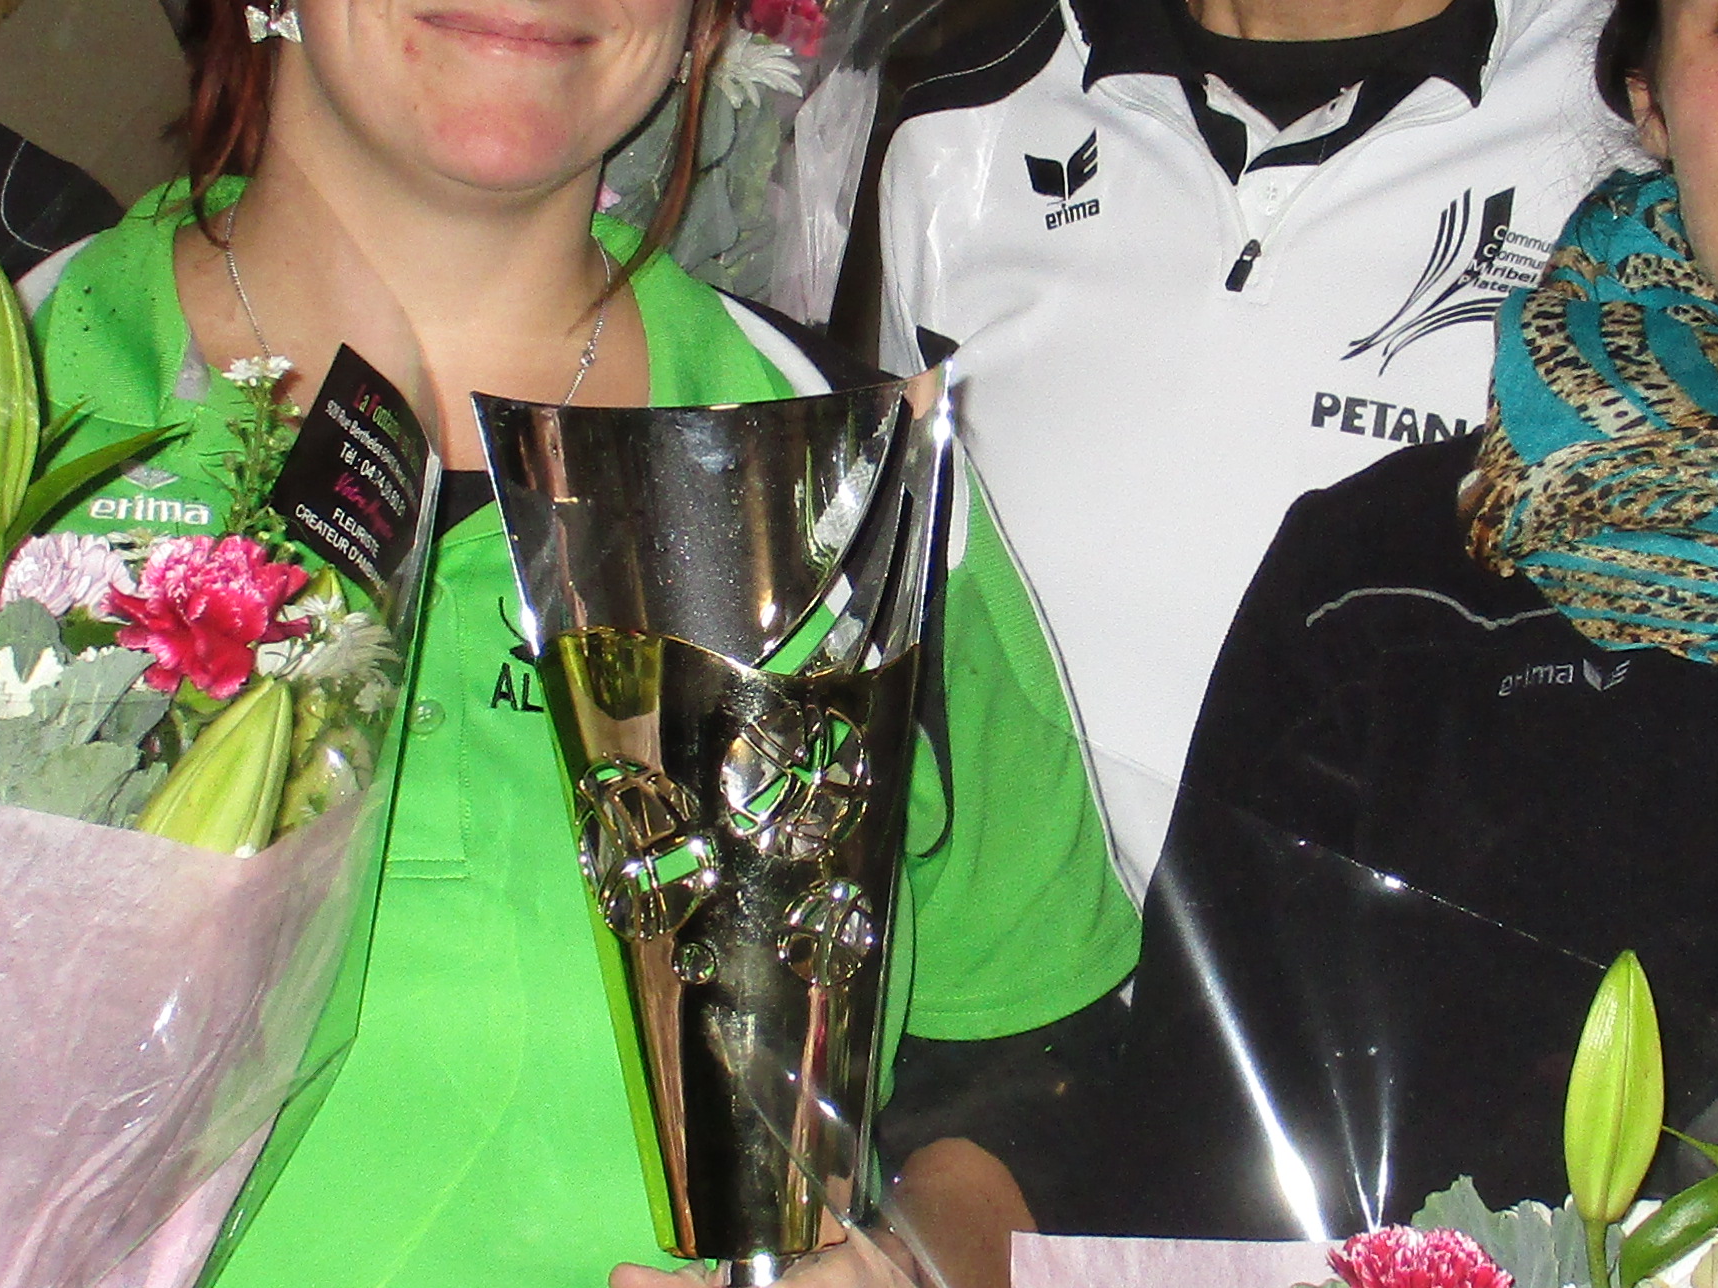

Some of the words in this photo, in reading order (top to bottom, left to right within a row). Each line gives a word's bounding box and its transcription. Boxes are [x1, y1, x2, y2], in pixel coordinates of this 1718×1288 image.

[1044, 198, 1101, 231] erima
[1467, 258, 1539, 285] Miribel
[1310, 391, 1483, 445] PETAN
[340, 441, 358, 466] Tél
[89, 494, 211, 526] erima
[295, 503, 350, 555] CREATEUR
[332, 507, 381, 559] FLEURISTE
[1497, 662, 1575, 697] erima
